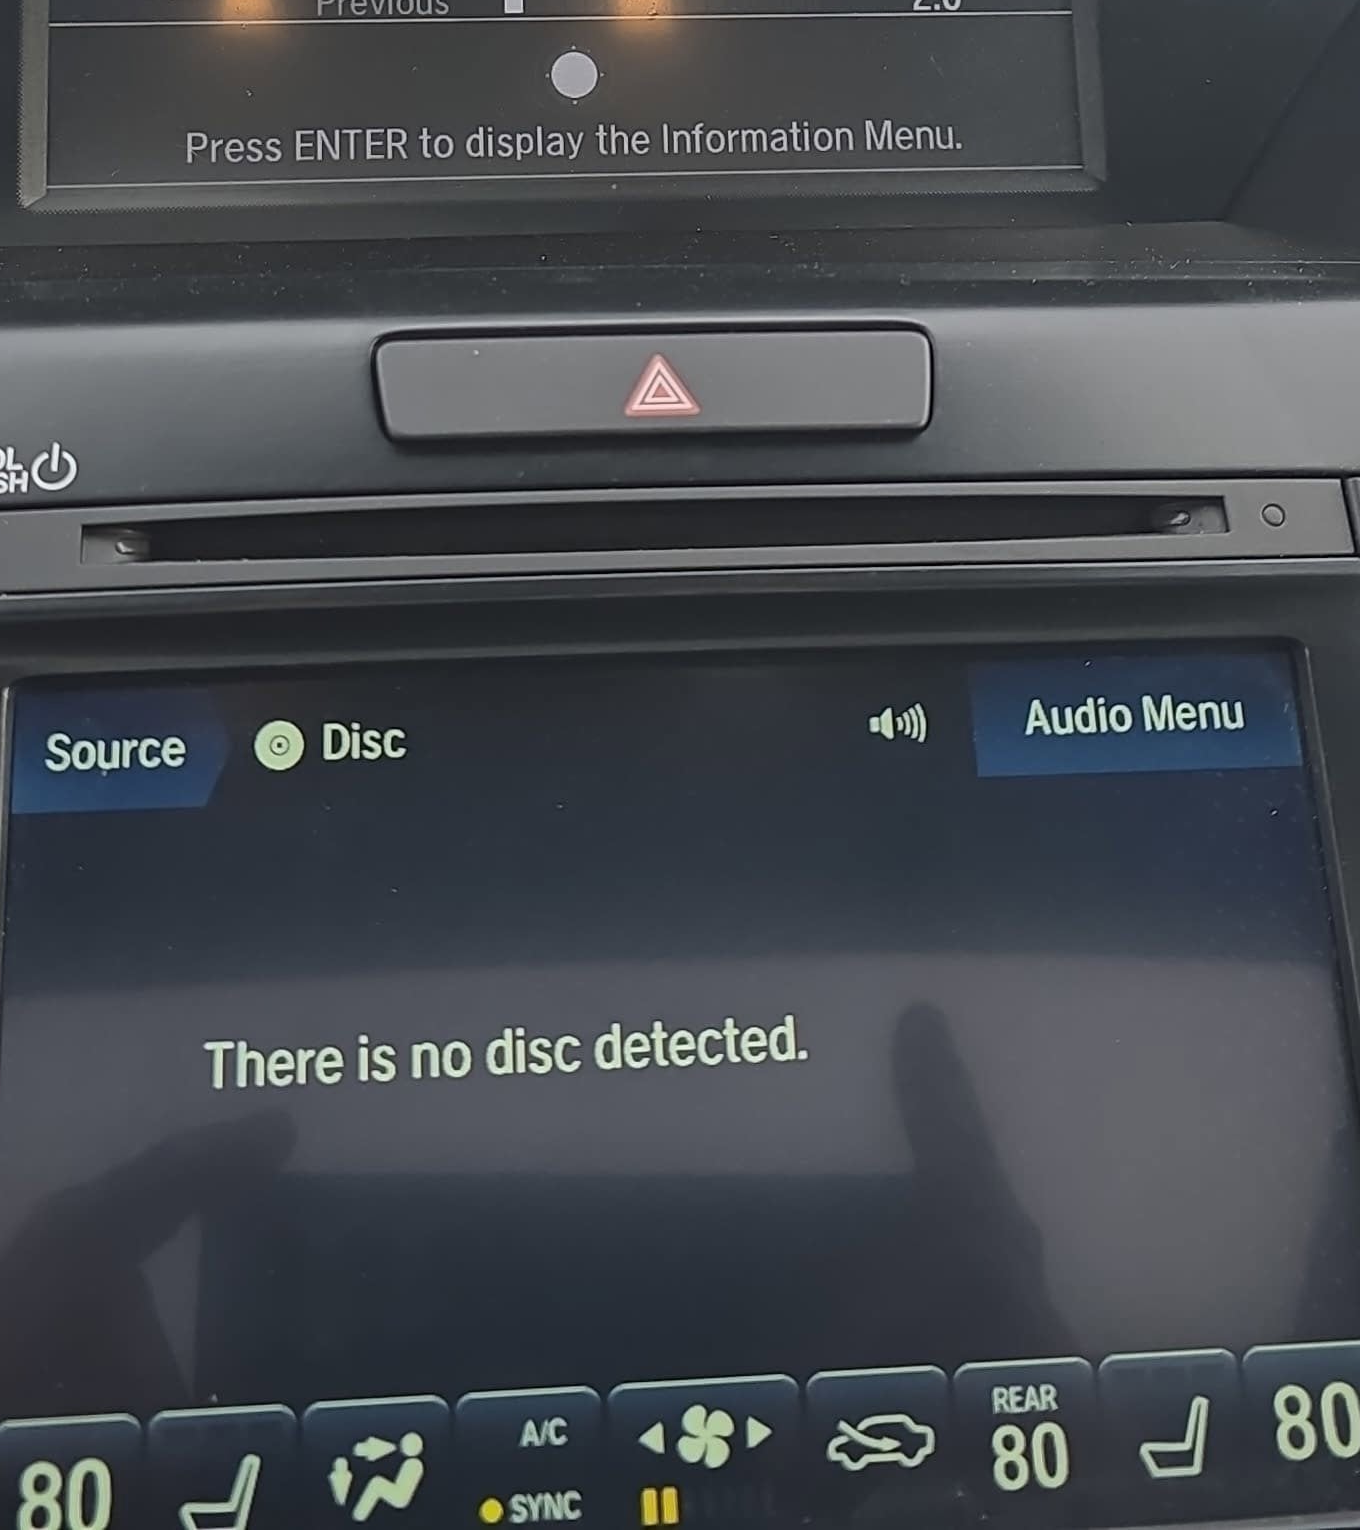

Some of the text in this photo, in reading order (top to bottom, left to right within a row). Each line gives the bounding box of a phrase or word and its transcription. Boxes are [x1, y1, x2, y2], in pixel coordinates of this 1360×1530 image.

[186, 119, 962, 164] Press ENTER to display the Information Menu.
[1025, 694, 1245, 736] Audio Menu
[44, 733, 186, 772] Source
[323, 722, 407, 761] Disc
[203, 1014, 808, 1090] There is no disc detected.
[992, 1383, 1058, 1414] REAR
[519, 1417, 568, 1447] A/C
[991, 1421, 1069, 1491] 80
[17, 1457, 112, 1530] 80
[509, 1490, 582, 1524] SYNC
